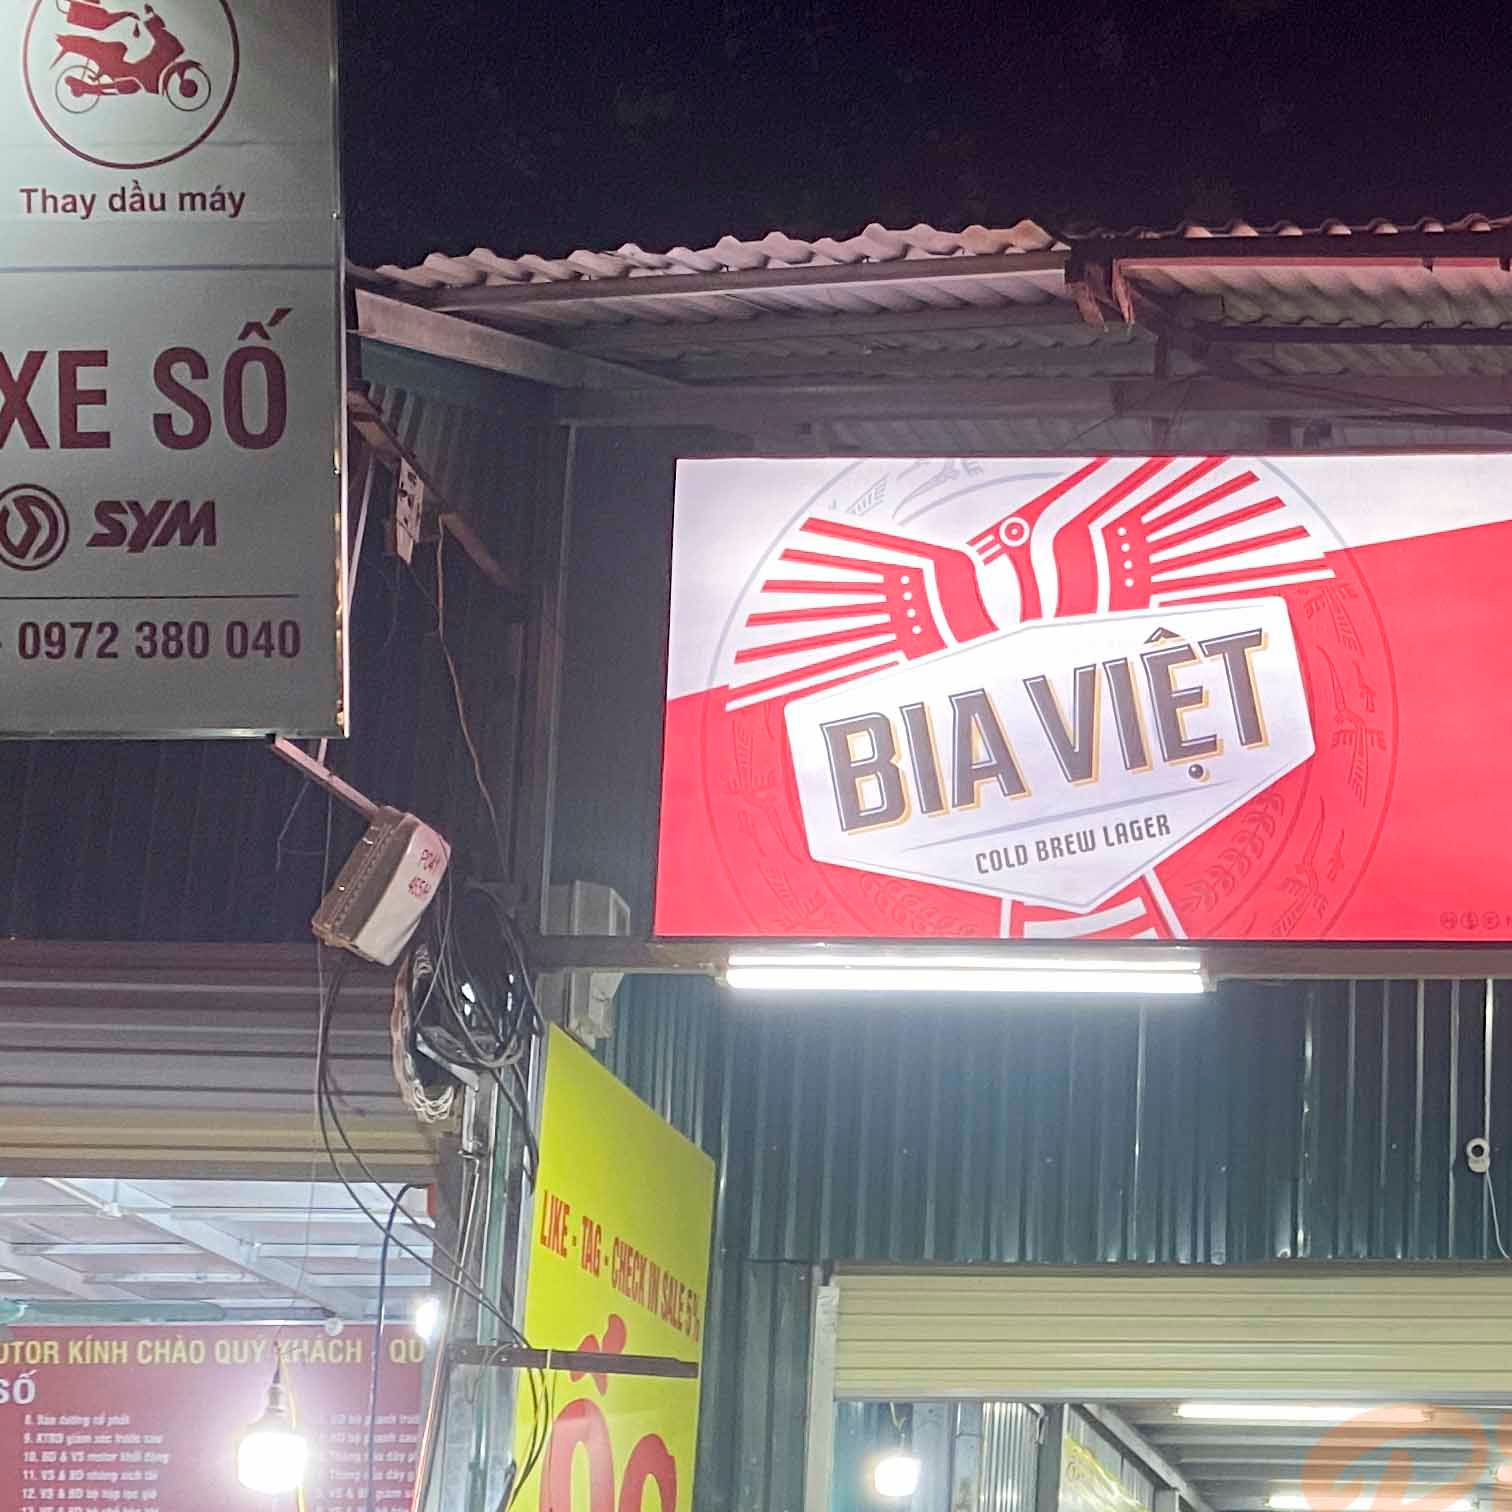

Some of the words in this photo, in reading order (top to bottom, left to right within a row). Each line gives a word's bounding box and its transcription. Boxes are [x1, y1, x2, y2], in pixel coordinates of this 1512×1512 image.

[19, 186, 97, 218] Thay
[108, 179, 167, 214] dầu
[178, 184, 246, 216] máy
[0, 350, 111, 449] XE
[153, 308, 293, 450] SỐ
[86, 500, 217, 553] SYM
[18, 622, 119, 659] 0972
[135, 621, 209, 659] 380
[226, 620, 300, 658] 040
[820, 688, 1029, 833] BIA
[1024, 626, 1268, 784] VIỆT
[976, 844, 1028, 874] COLD
[1035, 829, 1096, 862] BREW
[1103, 814, 1171, 847] LAGER
[540, 1189, 571, 1258] LIKE
[581, 1215, 602, 1278] TAG
[611, 1236, 648, 1308] CHECK
[661, 1270, 685, 1332] SALE
[67, 1334, 129, 1364] KÍNH
[136, 1334, 205, 1365] CHÀO
[215, 1335, 266, 1365] QUÝ
[279, 1334, 361, 1364] KHÁCH
